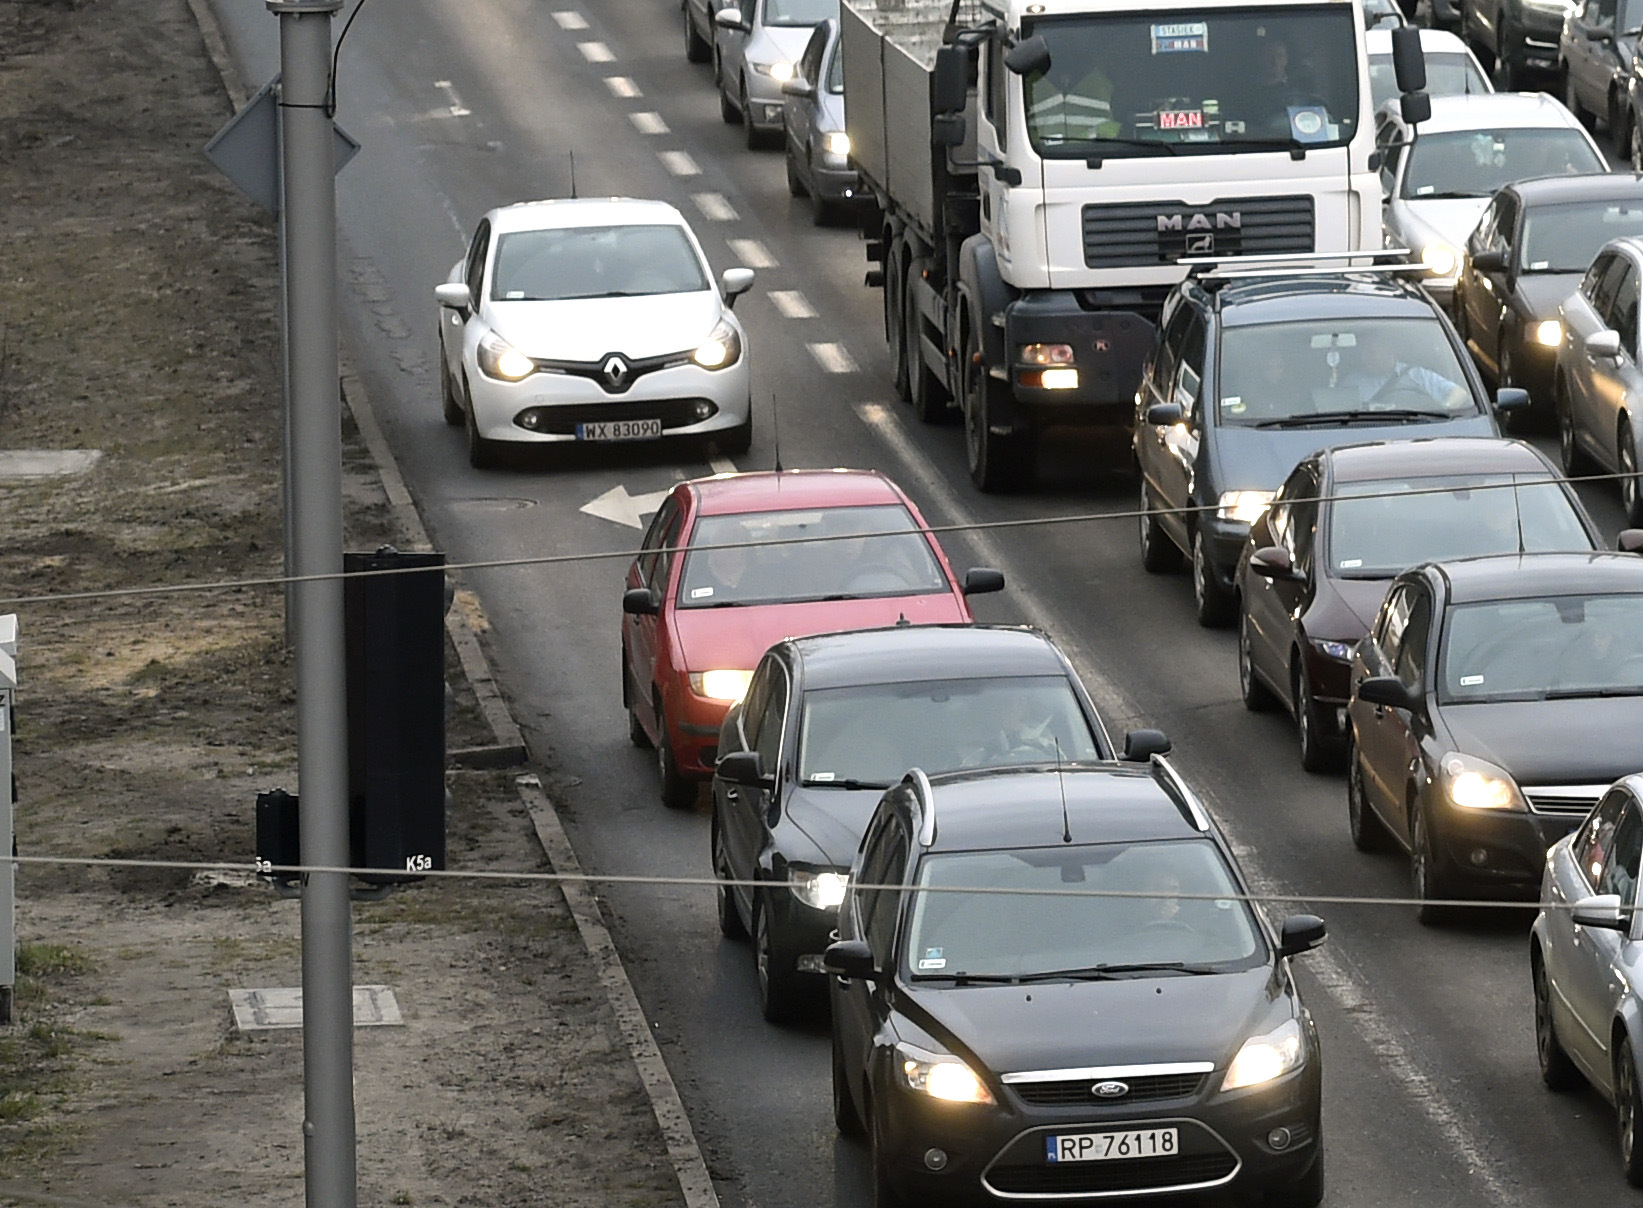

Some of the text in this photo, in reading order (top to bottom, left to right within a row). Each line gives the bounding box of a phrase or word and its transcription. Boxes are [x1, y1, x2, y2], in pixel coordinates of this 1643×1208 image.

[1160, 112, 1202, 128] MAN
[1157, 212, 1241, 231] MAN
[585, 421, 659, 438] WX 83090
[406, 854, 432, 872] K5a
[1061, 1131, 1174, 1159] RP 76118
